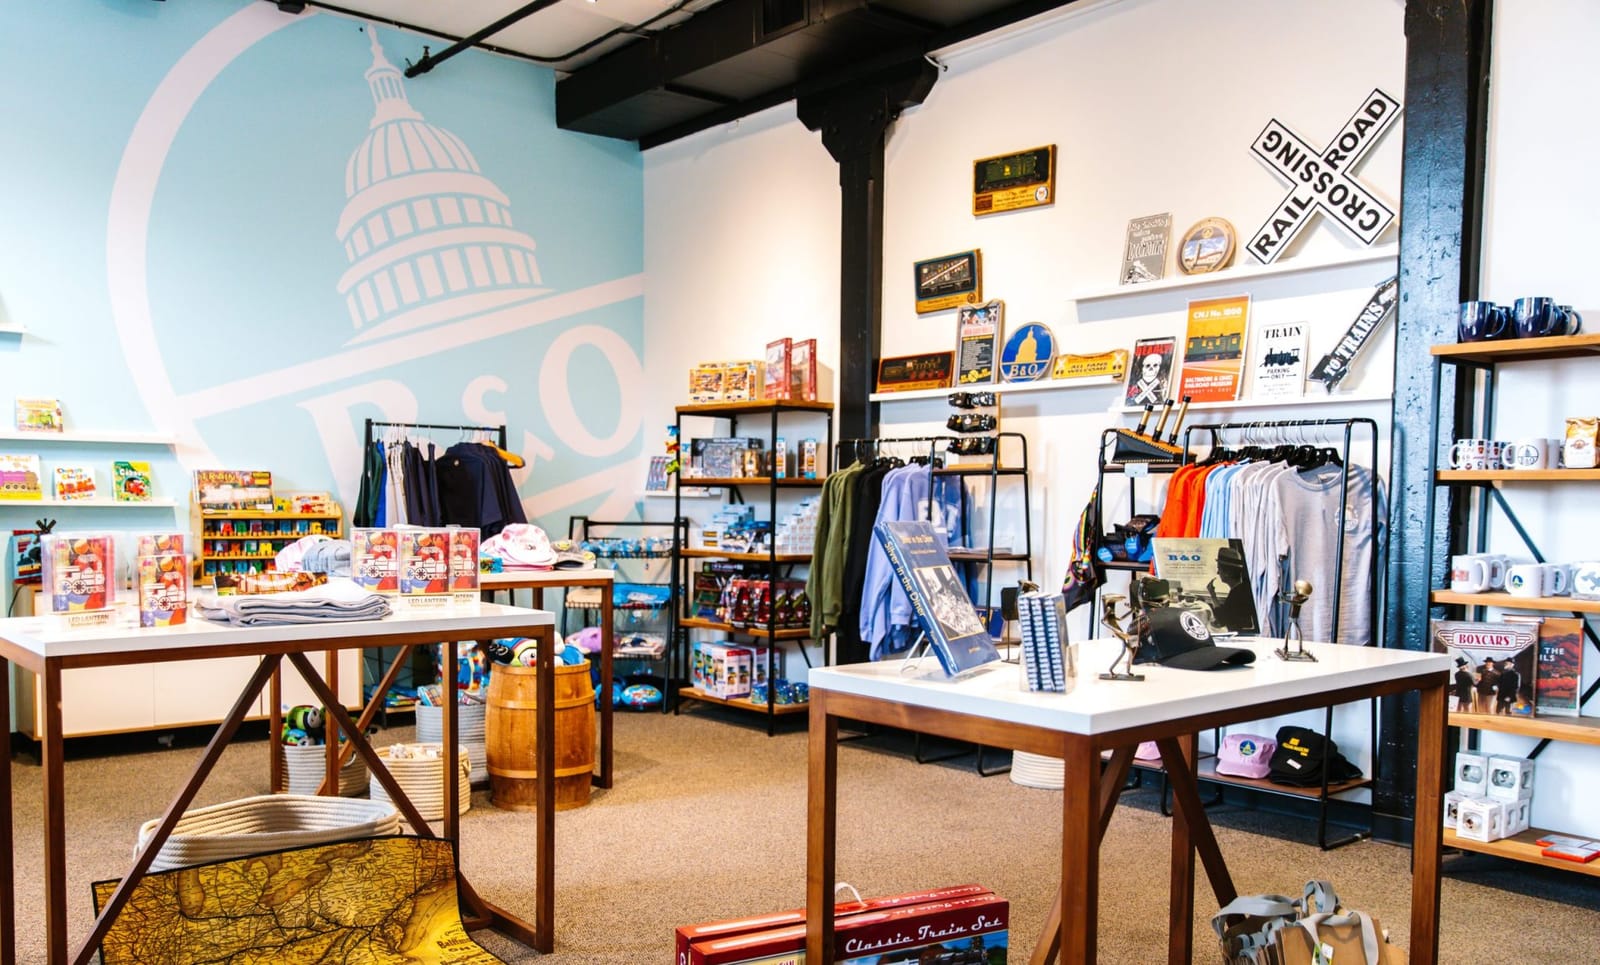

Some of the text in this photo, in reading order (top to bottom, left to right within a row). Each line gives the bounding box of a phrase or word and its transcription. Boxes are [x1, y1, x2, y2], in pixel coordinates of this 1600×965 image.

[1254, 98, 1388, 255] RAIL ROAD
[1261, 129, 1381, 231] CROSSING
[1264, 326, 1302, 339] TRAIN
[1335, 301, 1385, 359] TRAINS
[1010, 364, 1038, 378] B&O
[897, 565, 905, 577] in
[902, 576, 912, 592] the
[910, 592, 925, 616] Diner
[68, 616, 81, 624] LED
[81, 614, 109, 623] LANTERN
[1459, 634, 1510, 646] BOXCARS
[1544, 647, 1565, 655] THE
[845, 915, 1003, 953] Classic Train Set
